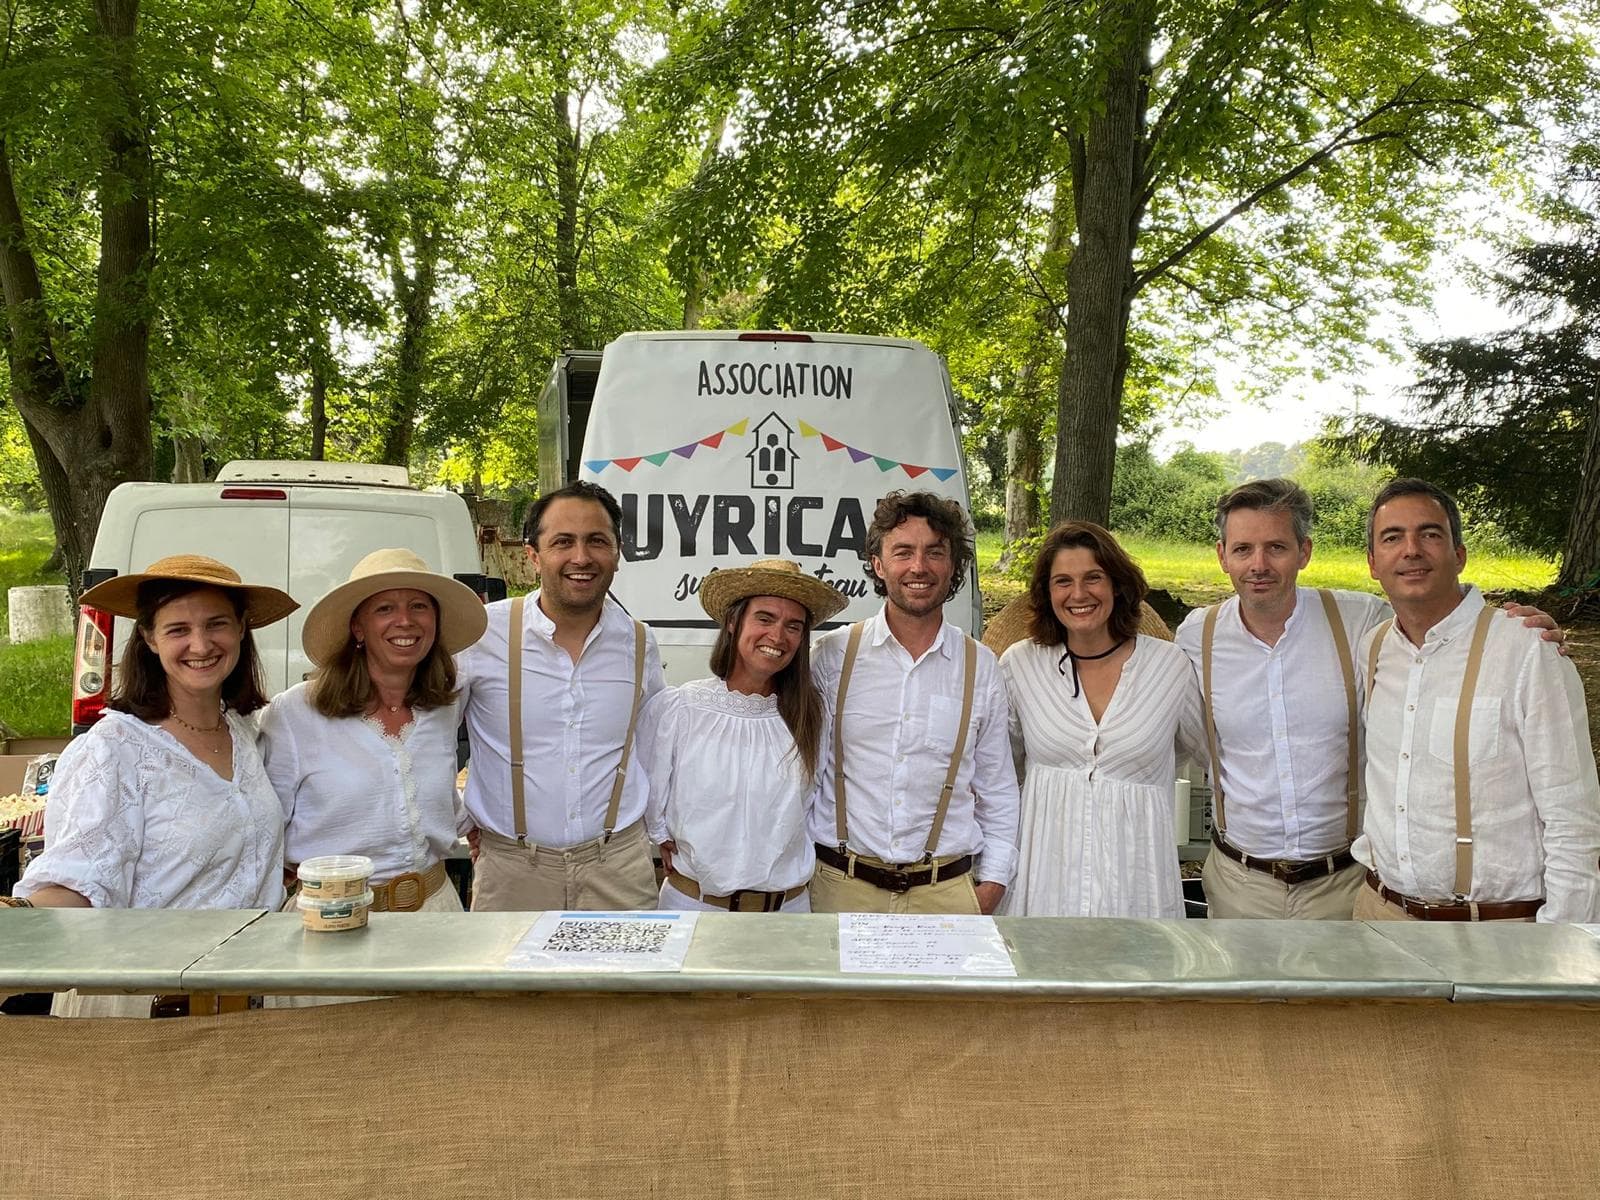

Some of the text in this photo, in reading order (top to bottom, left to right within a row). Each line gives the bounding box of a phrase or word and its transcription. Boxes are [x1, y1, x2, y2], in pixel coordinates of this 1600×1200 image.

[698, 360, 852, 399] ASSOCIATION
[621, 493, 880, 562] UYRICA
[674, 570, 711, 602] su
